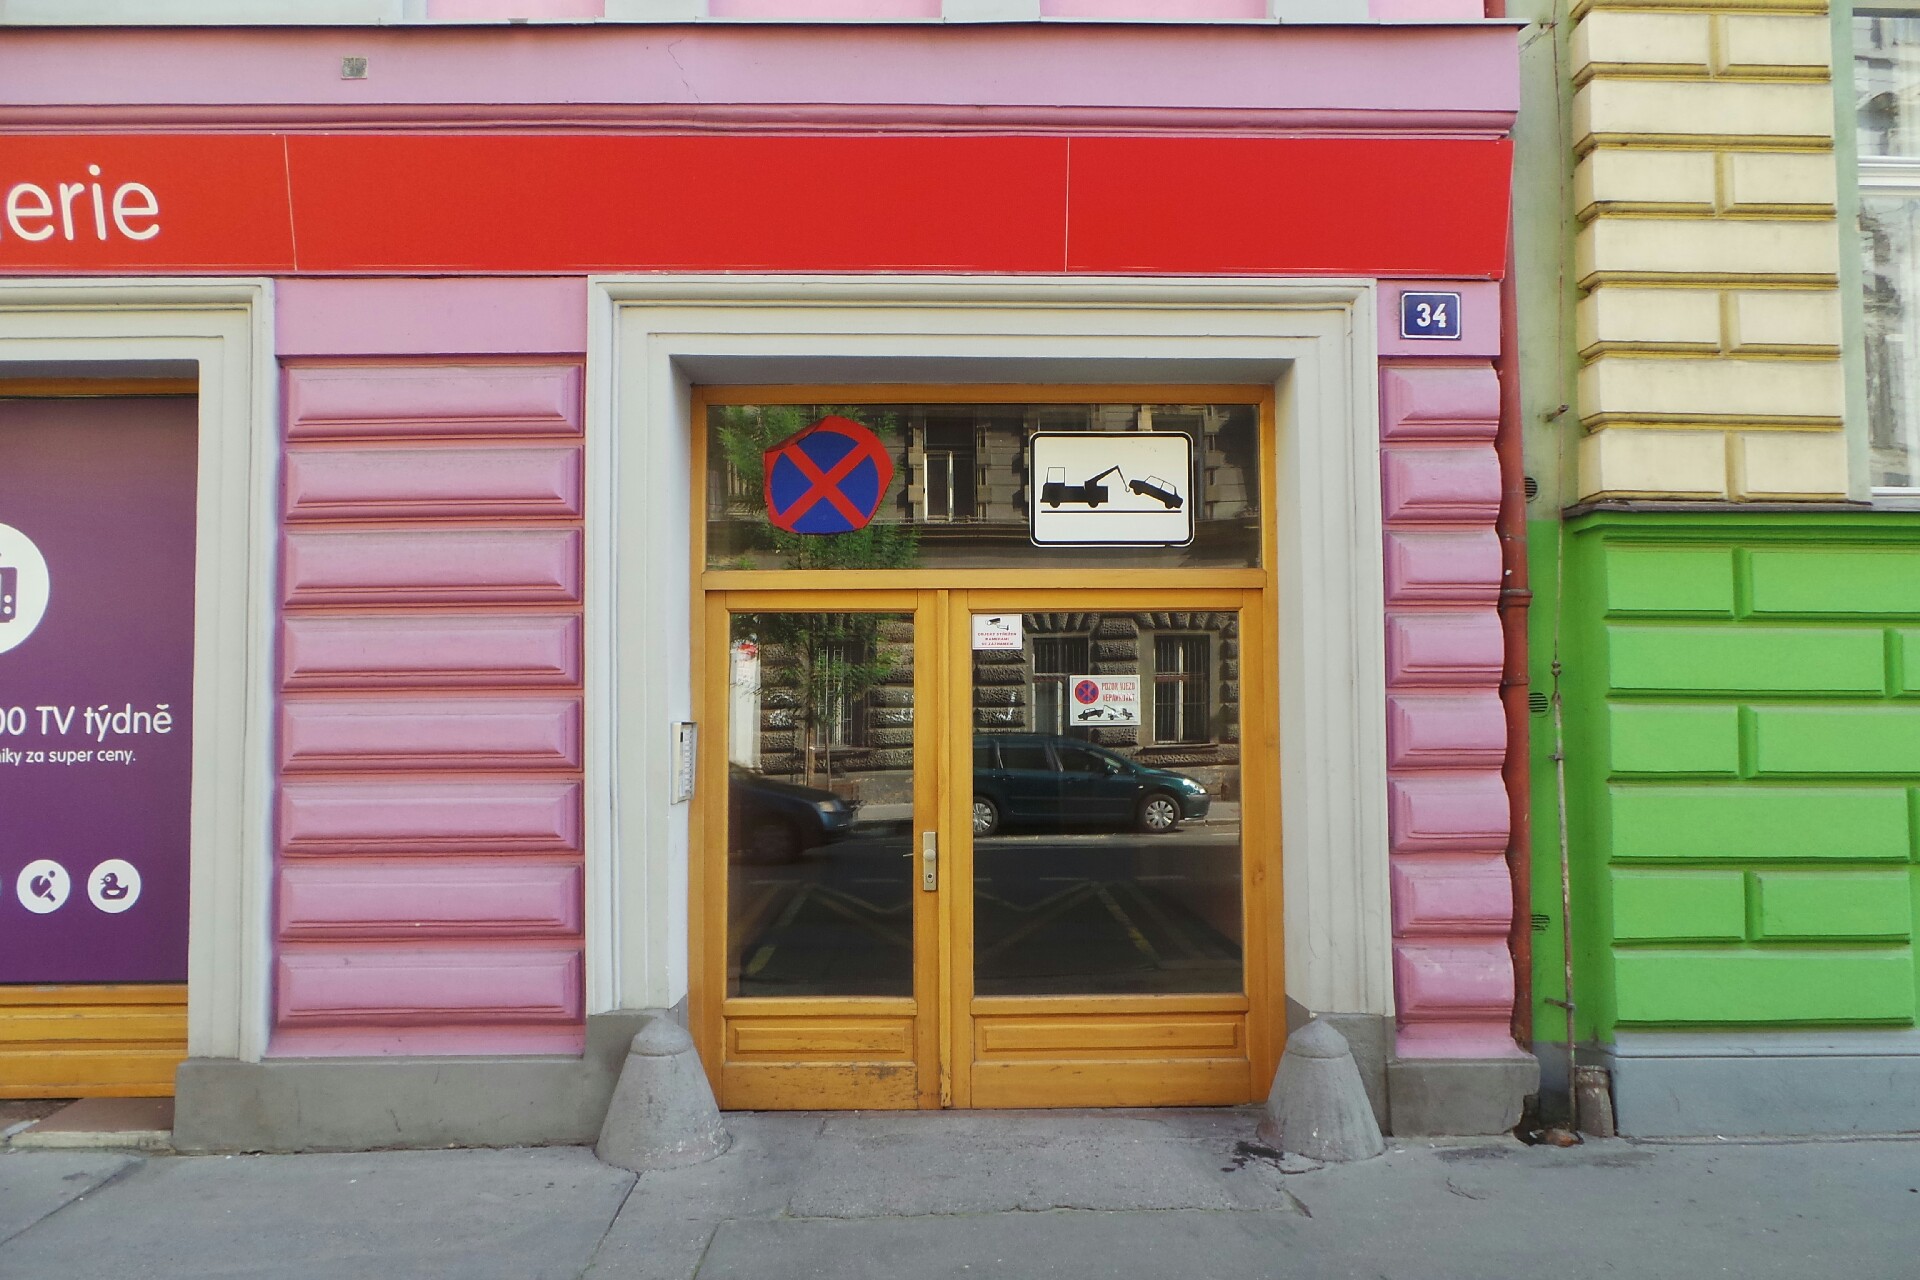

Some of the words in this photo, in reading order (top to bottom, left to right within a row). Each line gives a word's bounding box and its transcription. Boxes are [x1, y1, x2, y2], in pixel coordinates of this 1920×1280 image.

[0, 164, 160, 241] erie
[1416, 303, 1447, 328] 34
[35, 705, 76, 735] TV
[84, 702, 173, 742] týdně
[0, 747, 22, 767] iky
[25, 751, 45, 763] za
[48, 750, 94, 766] super
[97, 750, 137, 766] ceny.
